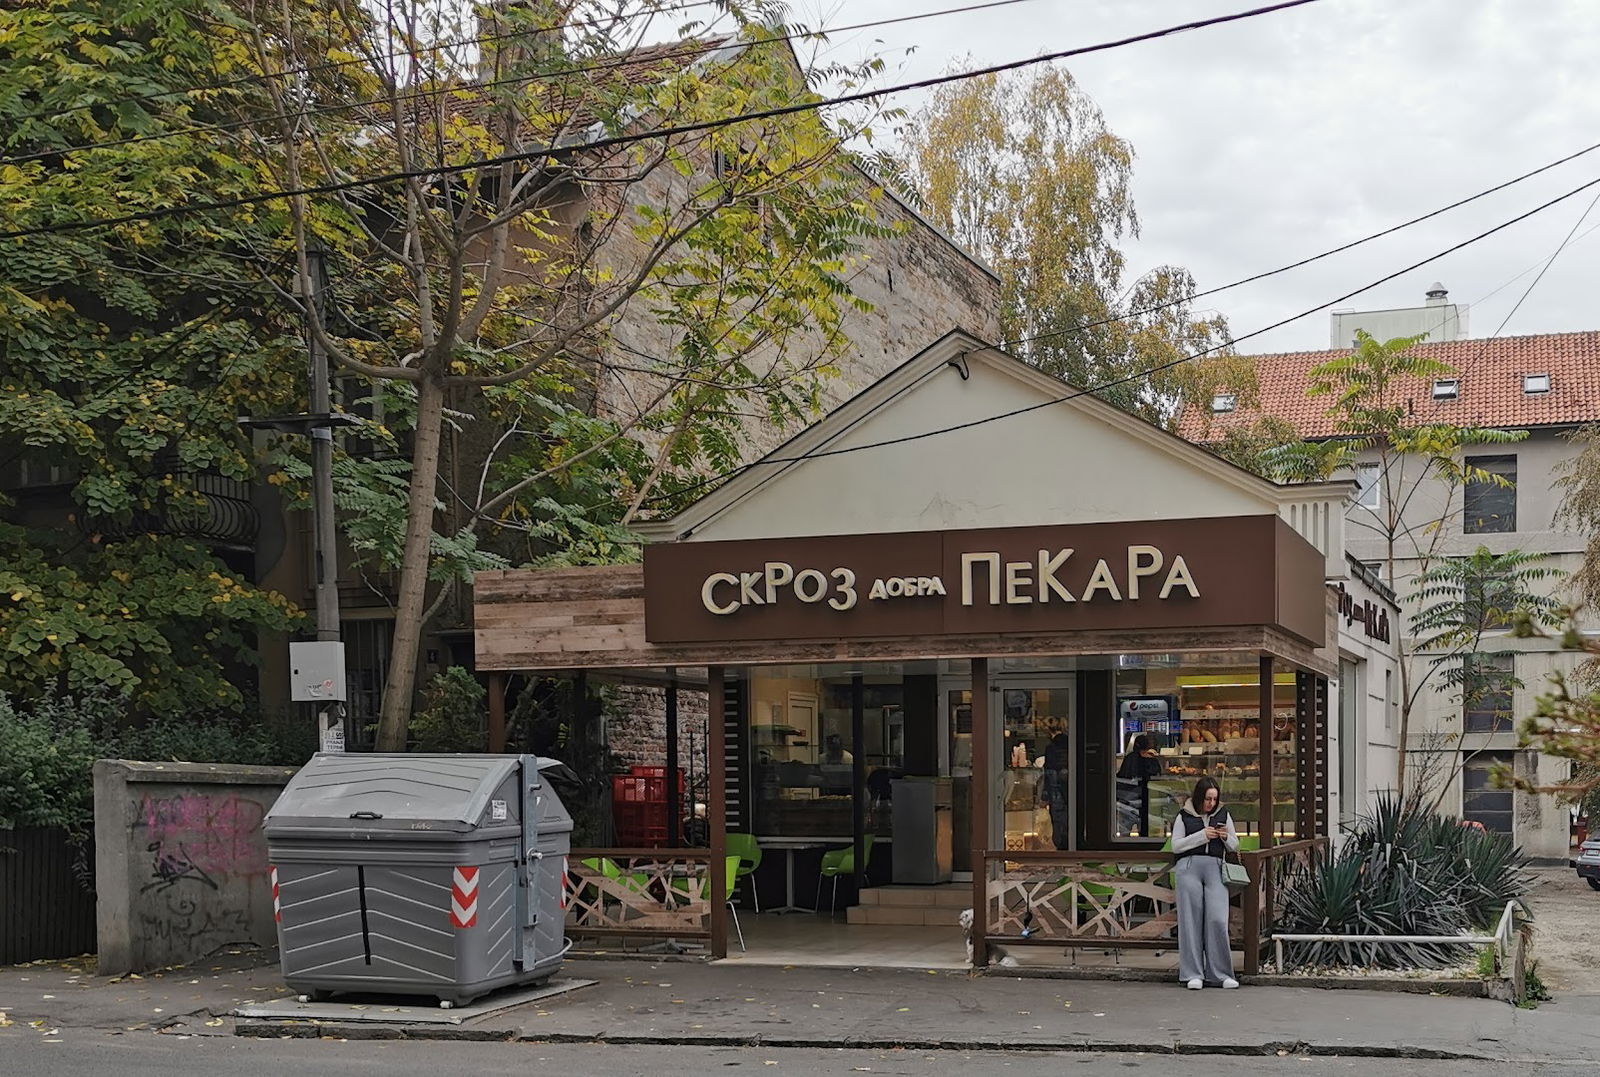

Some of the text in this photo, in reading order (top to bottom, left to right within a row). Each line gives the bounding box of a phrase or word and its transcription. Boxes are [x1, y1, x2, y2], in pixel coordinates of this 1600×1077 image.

[701, 545, 1201, 615] СКРОЗ ДОБРА ПЕКАРА
